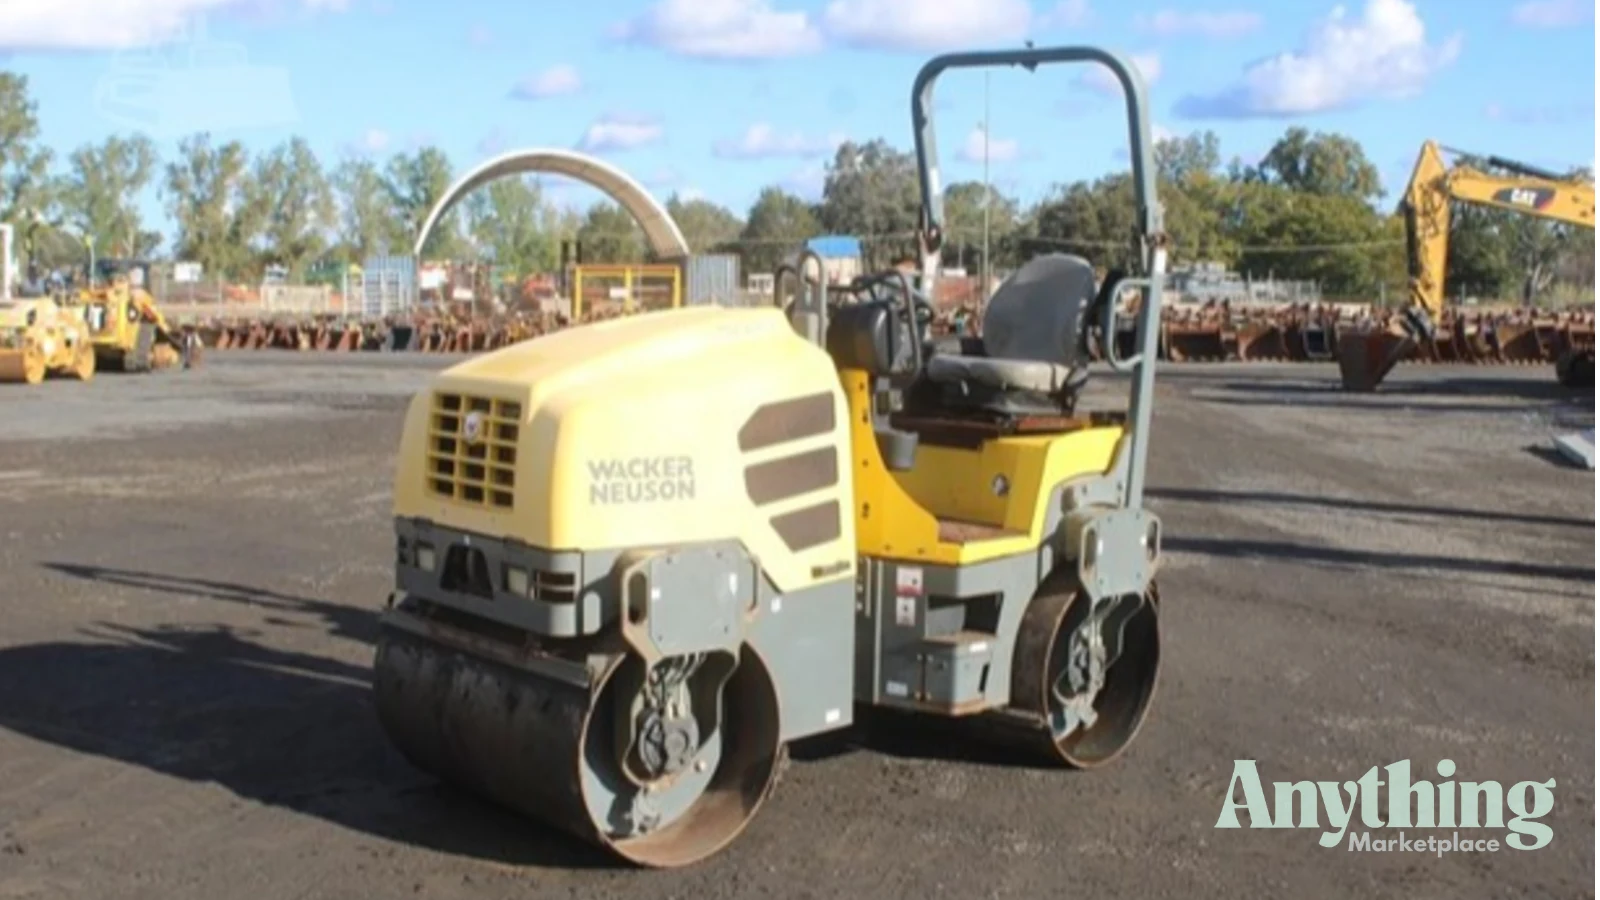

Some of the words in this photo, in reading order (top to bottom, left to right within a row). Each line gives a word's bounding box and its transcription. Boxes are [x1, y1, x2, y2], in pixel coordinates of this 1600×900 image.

[1511, 187, 1538, 206] CAT
[588, 456, 694, 480] WACKER
[590, 479, 696, 504] NEUSON
